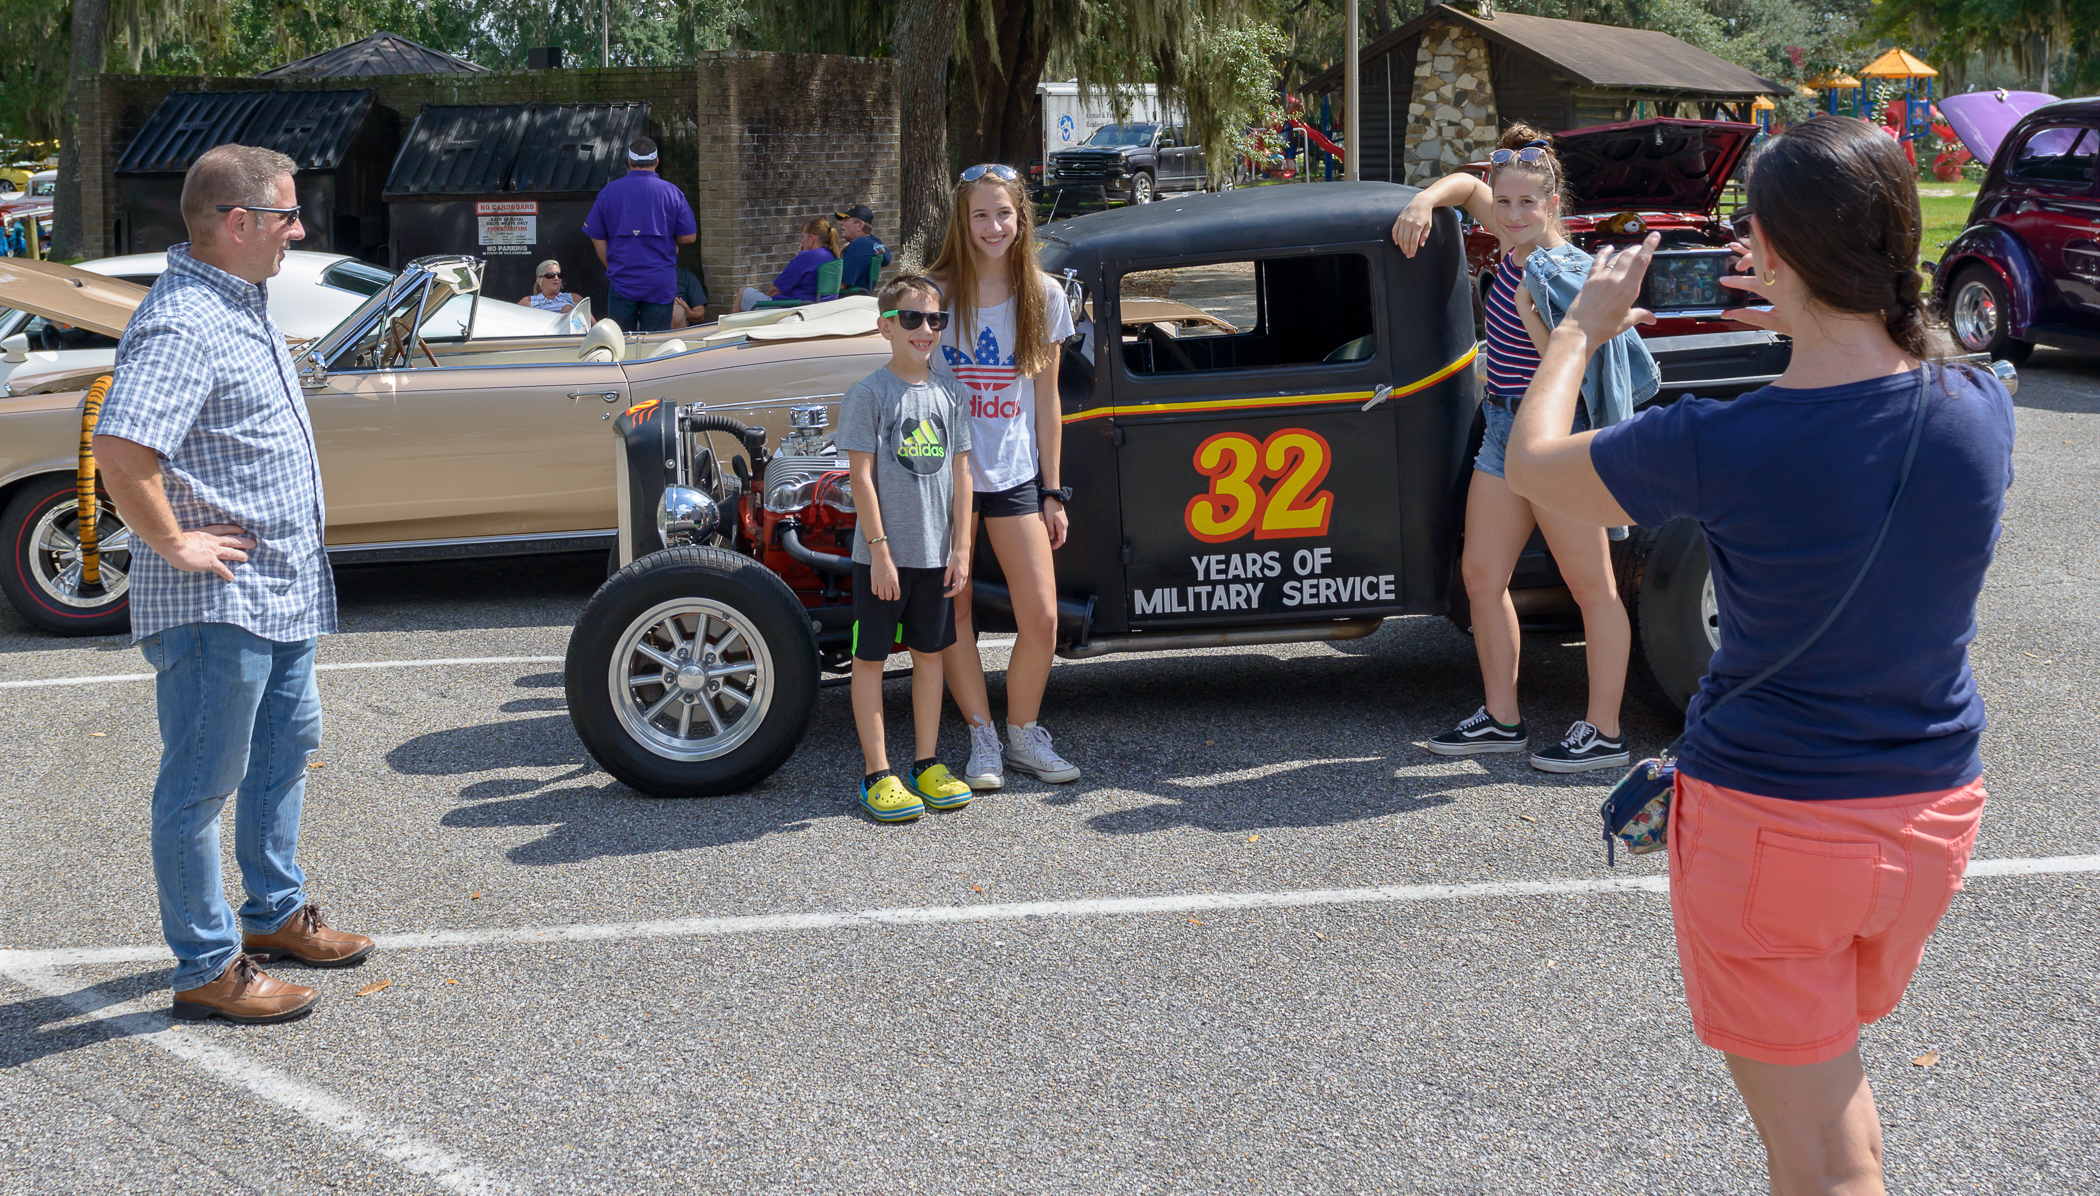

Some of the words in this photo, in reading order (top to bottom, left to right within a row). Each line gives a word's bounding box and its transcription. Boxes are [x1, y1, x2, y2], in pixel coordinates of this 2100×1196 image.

[898, 442, 945, 457] adidas
[1184, 427, 1335, 543] 32
[1190, 551, 1281, 581] YEARS
[1293, 547, 1332, 576] OF
[1133, 582, 1264, 615] MILITARY
[1282, 575, 1396, 606] SERVICE
